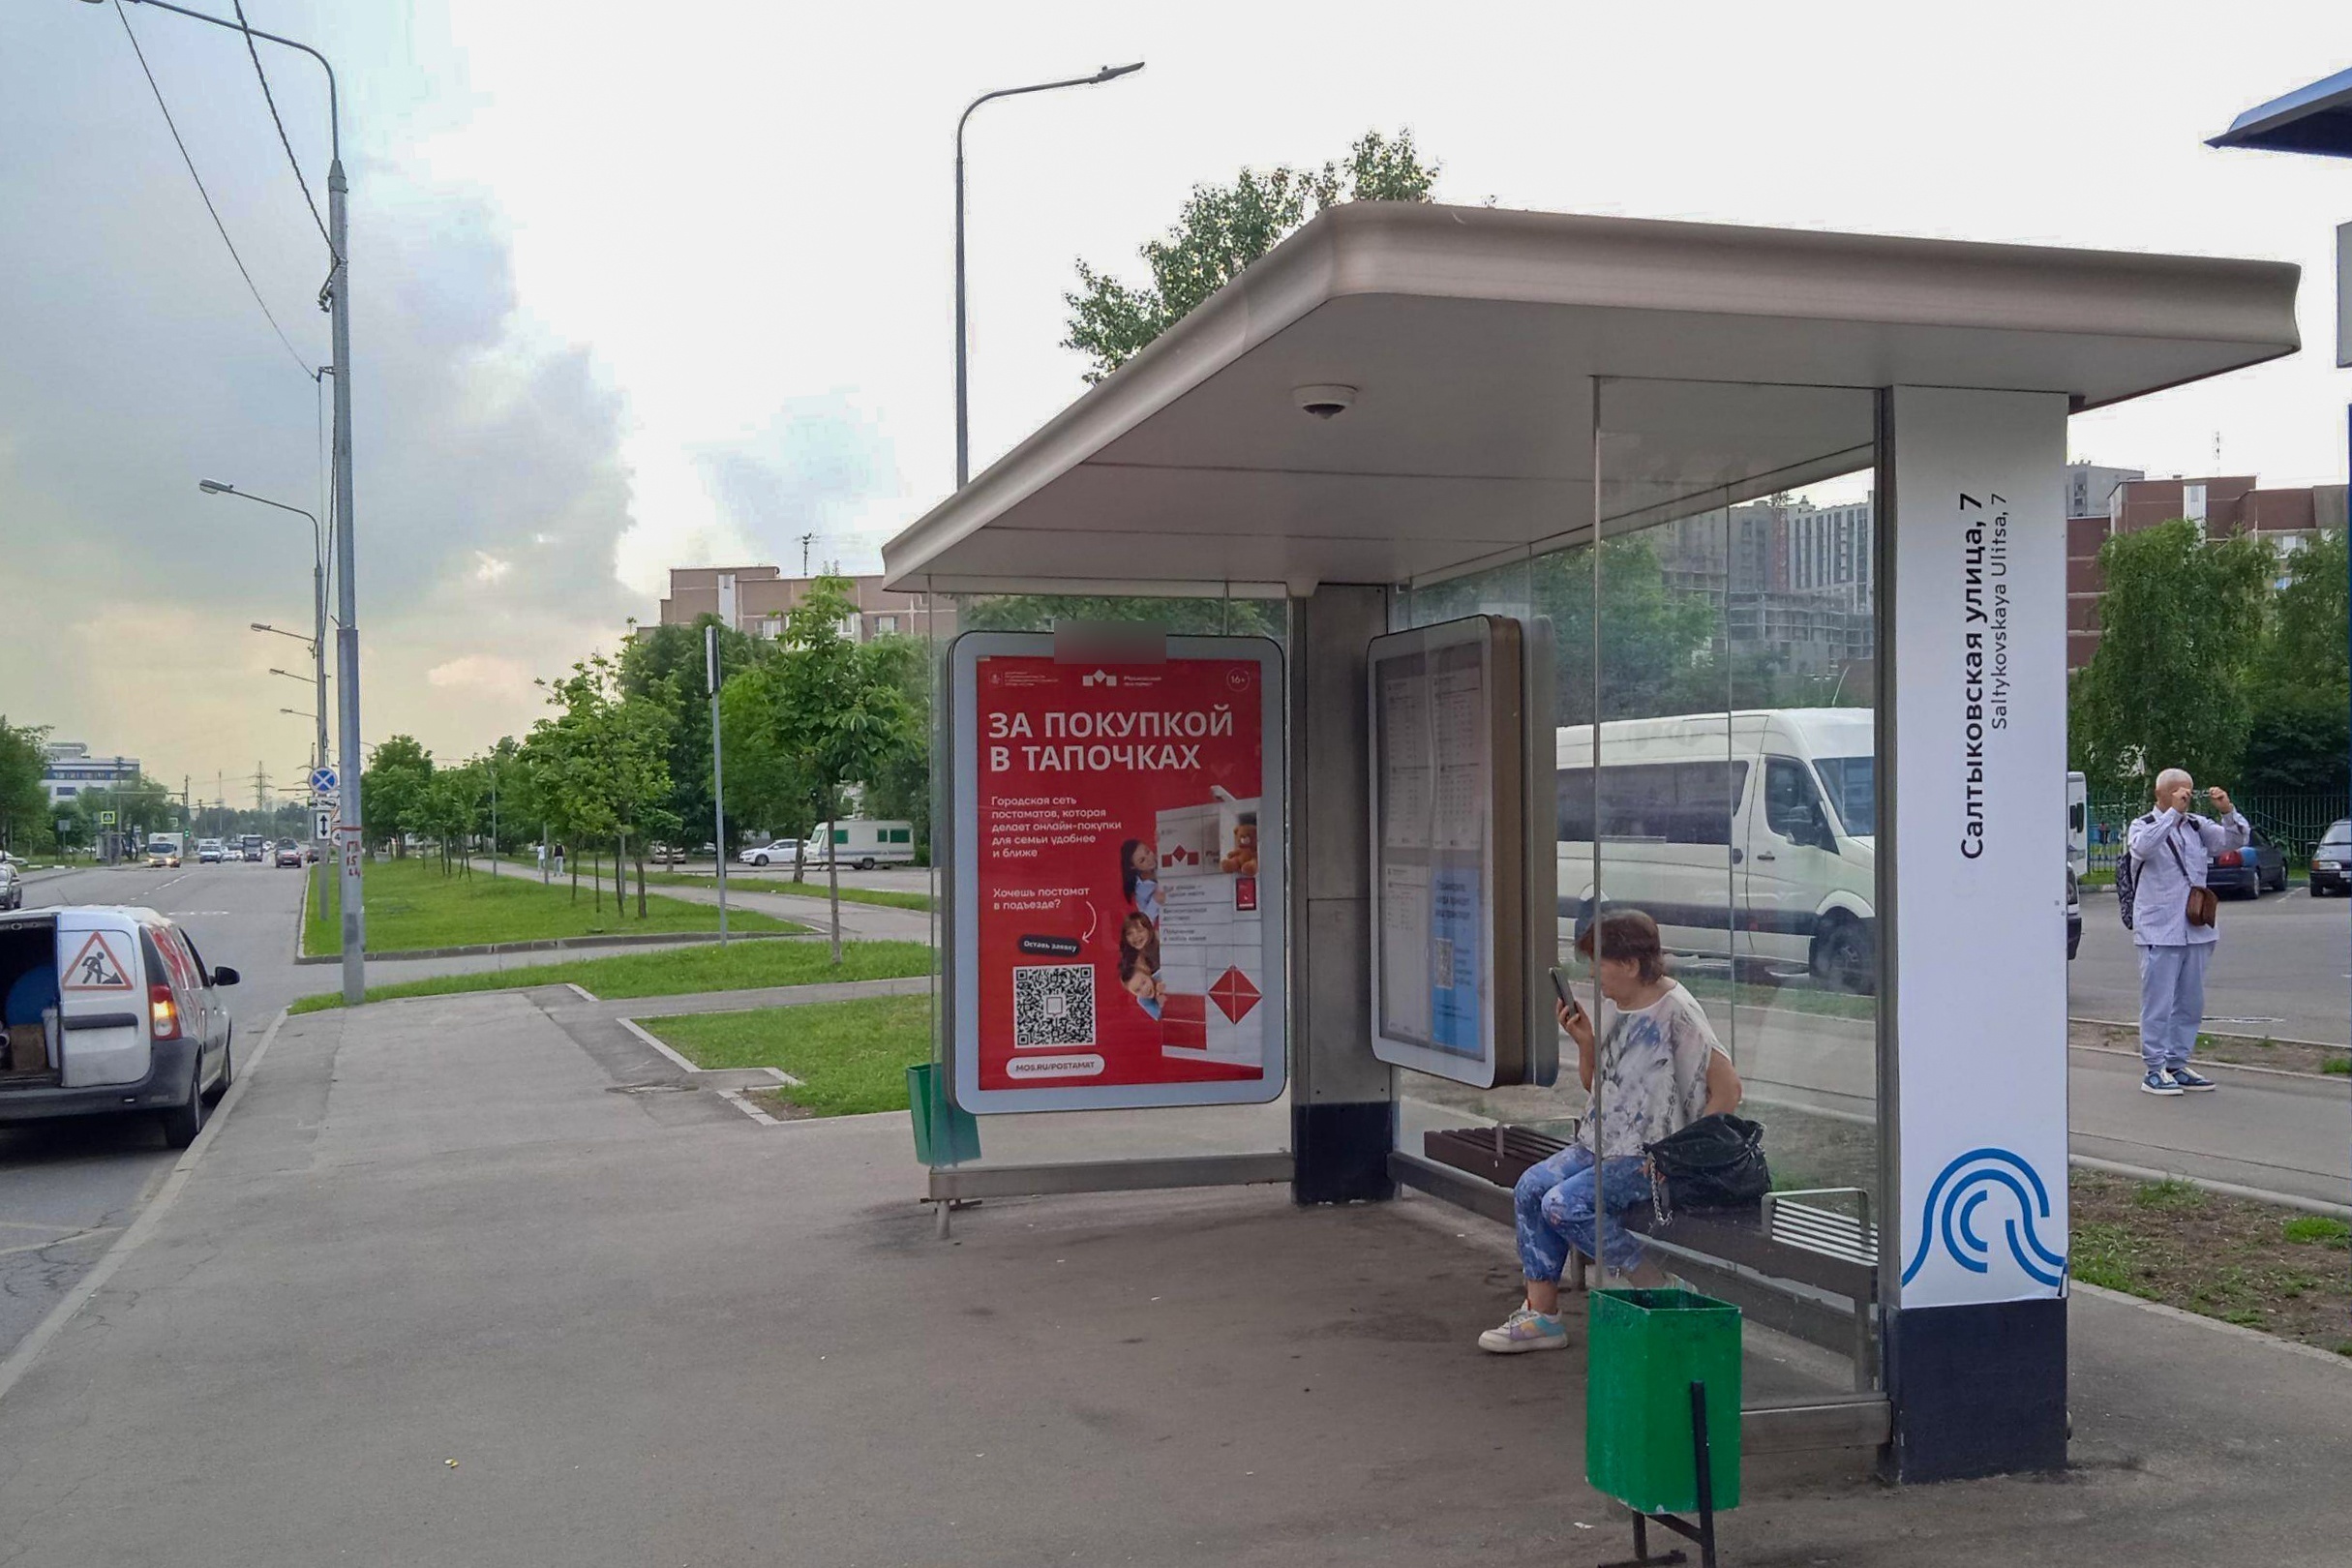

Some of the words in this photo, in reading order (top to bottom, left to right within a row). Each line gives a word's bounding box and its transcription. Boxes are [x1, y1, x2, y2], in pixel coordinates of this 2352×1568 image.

[1960, 492, 1983, 511] 7
[1991, 493, 2007, 504] 7
[1991, 511, 2008, 578] Ulitsa,
[1965, 519, 1988, 623] улица,
[1991, 583, 2010, 730] Saltykovskaya
[988, 711, 1033, 739] ЗА
[1044, 704, 1233, 739] ПОКУПКОЙ
[1960, 633, 1983, 859] Салтыковская
[990, 745, 1010, 772] В
[1021, 744, 1201, 772] ТАПОЧКАХ
[991, 796, 1050, 807] Городская
[1052, 797, 1077, 805] сеть
[991, 810, 1060, 819] постаматов,
[1062, 808, 1106, 819] которая
[991, 823, 1031, 832] делает
[1033, 821, 1122, 832] онлайн-покупки
[991, 836, 1011, 846] для
[1013, 835, 1048, 845] семьи
[1050, 833, 1097, 845] удобнее
[1002, 848, 1039, 858] ближе
[993, 888, 1036, 898] Хочешь
[1038, 887, 1091, 896] постамат
[1003, 899, 1061, 911] подъезде?
